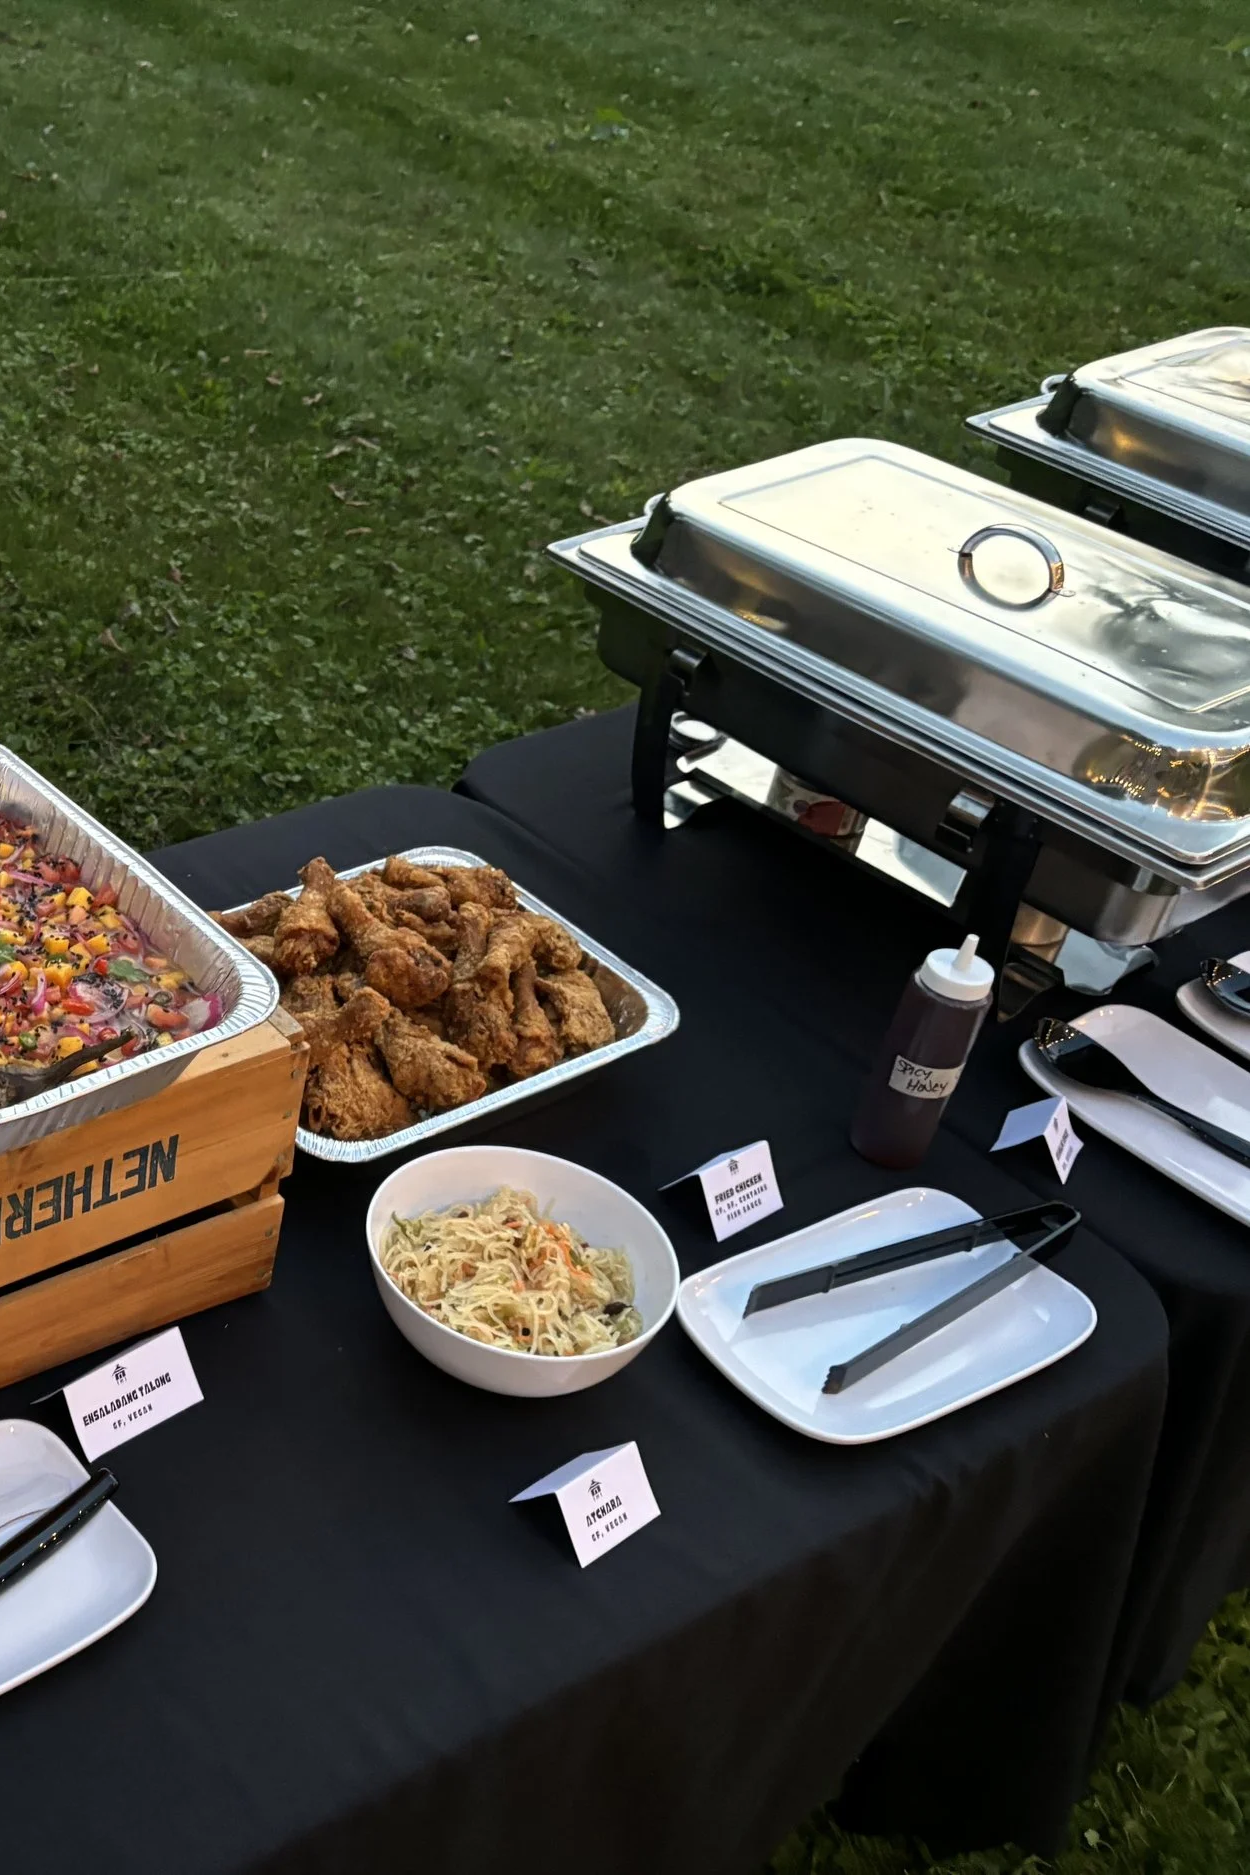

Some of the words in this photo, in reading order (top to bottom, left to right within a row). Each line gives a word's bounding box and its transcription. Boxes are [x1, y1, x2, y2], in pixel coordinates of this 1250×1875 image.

[714, 1189, 735, 1205] FRIED
[735, 1172, 762, 1194] CHICKEN
[739, 1184, 768, 1203] CONTAINS
[727, 1210, 741, 1221] FISH
[743, 1198, 762, 1213] SAUCE
[82, 1390, 138, 1427] ENSALADANG
[139, 1372, 172, 1397] TALONG
[128, 1403, 153, 1422] VEGAN
[585, 1495, 623, 1527] ATCHARA
[605, 1512, 628, 1533] VEGAN
